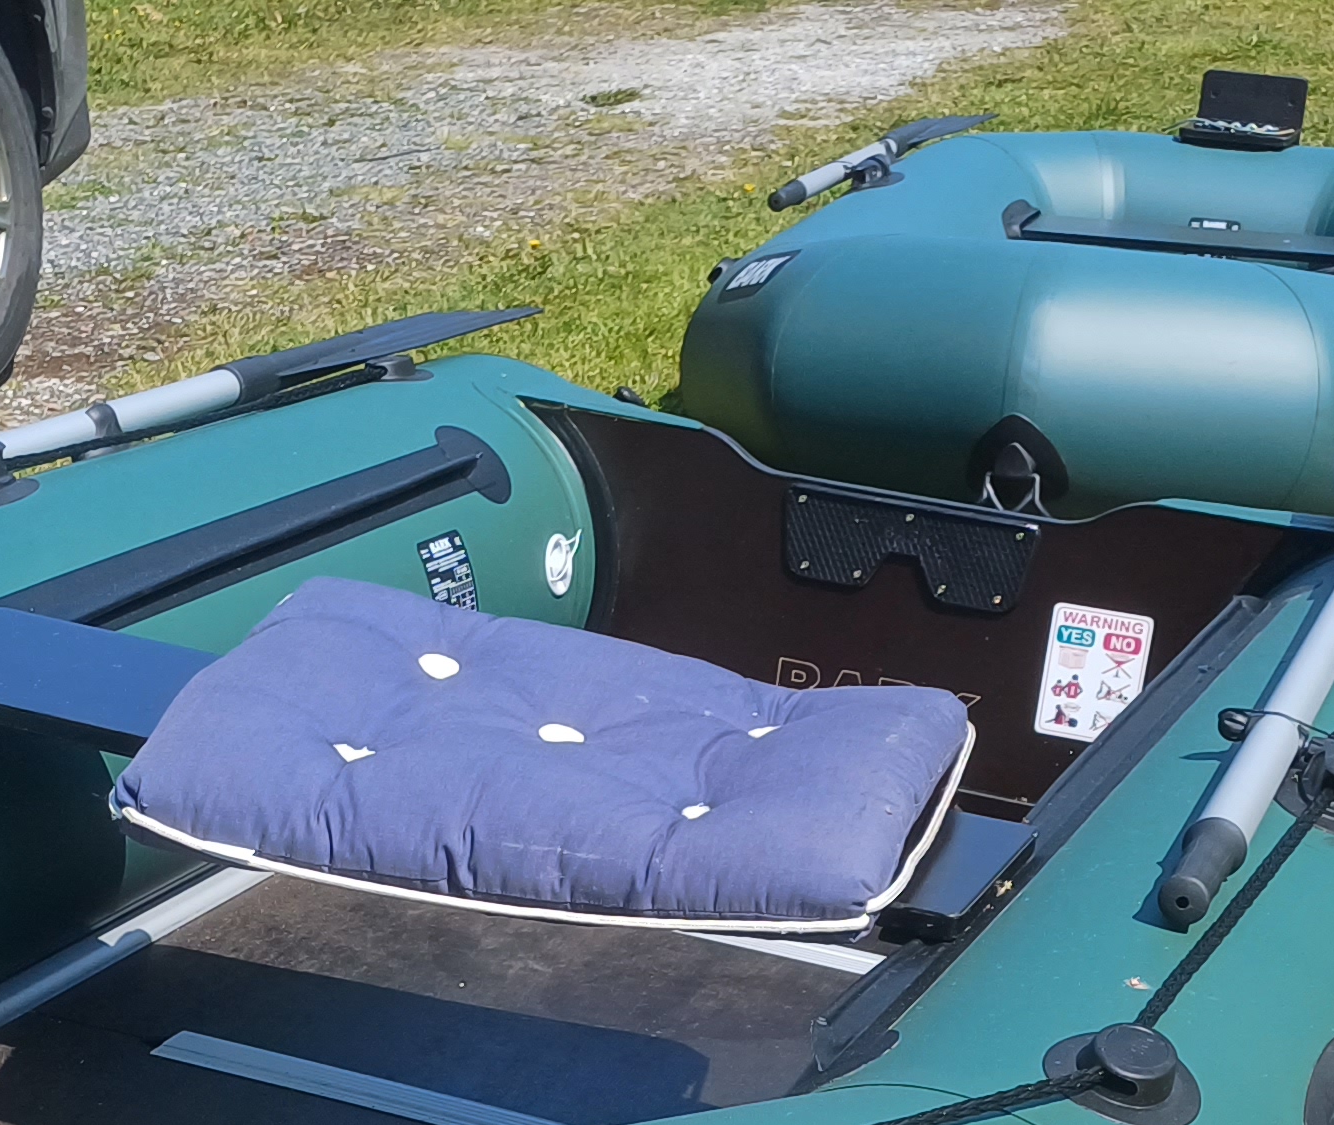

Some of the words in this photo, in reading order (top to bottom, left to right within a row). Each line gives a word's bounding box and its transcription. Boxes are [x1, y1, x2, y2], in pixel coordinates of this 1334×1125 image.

[1063, 610, 1145, 635] WARNING
[1061, 627, 1094, 646] YES
[1109, 635, 1136, 653] NO
